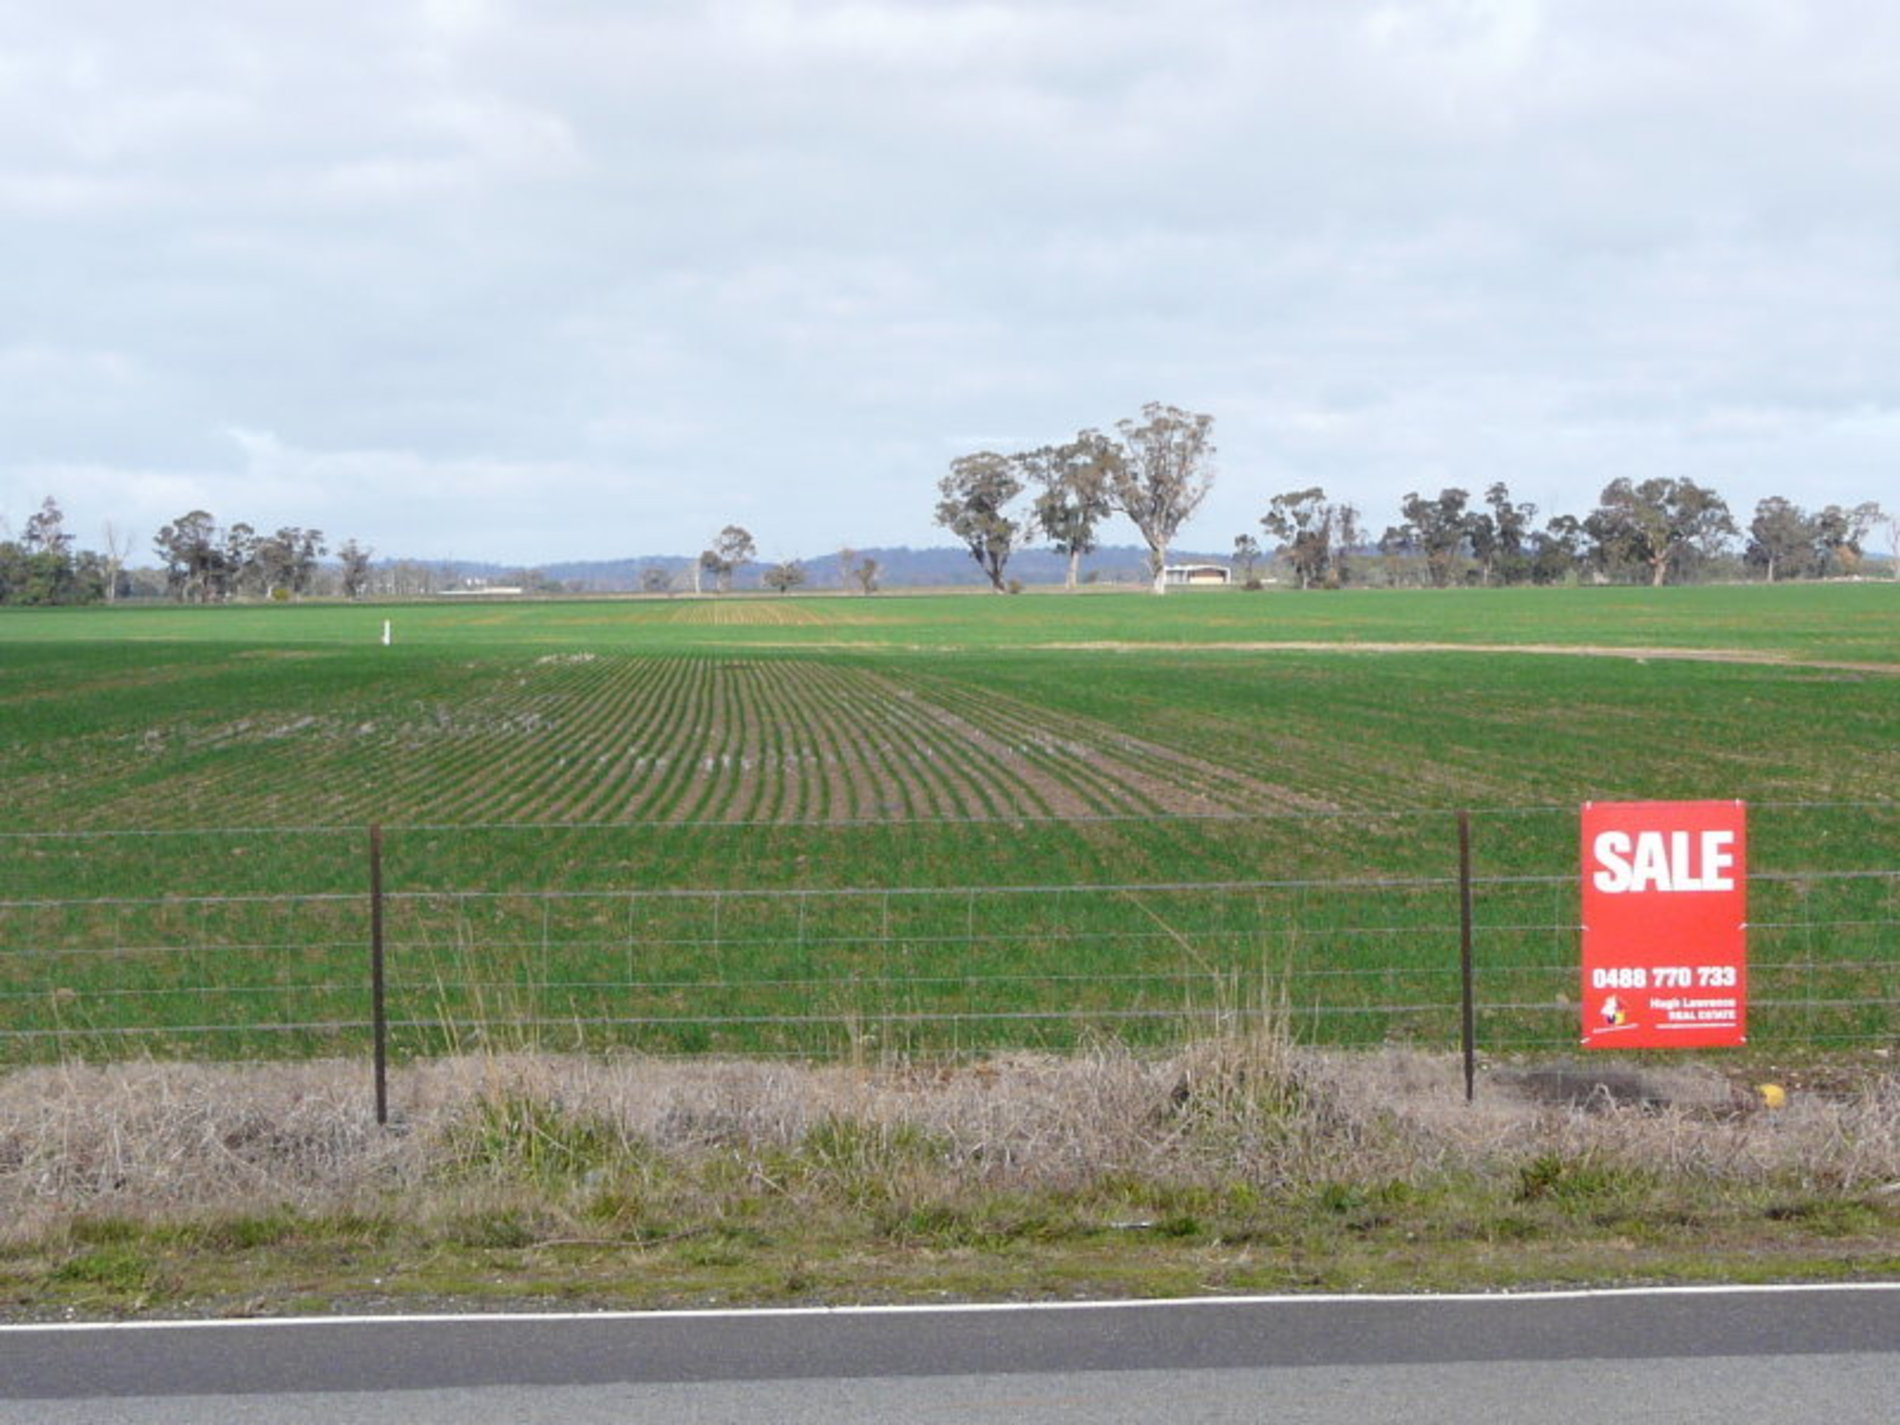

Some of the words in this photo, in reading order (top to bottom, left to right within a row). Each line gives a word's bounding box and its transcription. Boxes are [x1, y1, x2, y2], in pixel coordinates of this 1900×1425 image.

[1593, 830, 1735, 894] SALE
[1592, 968, 1647, 989] 0488
[1651, 967, 1692, 988] 770
[1696, 966, 1737, 987] 733
